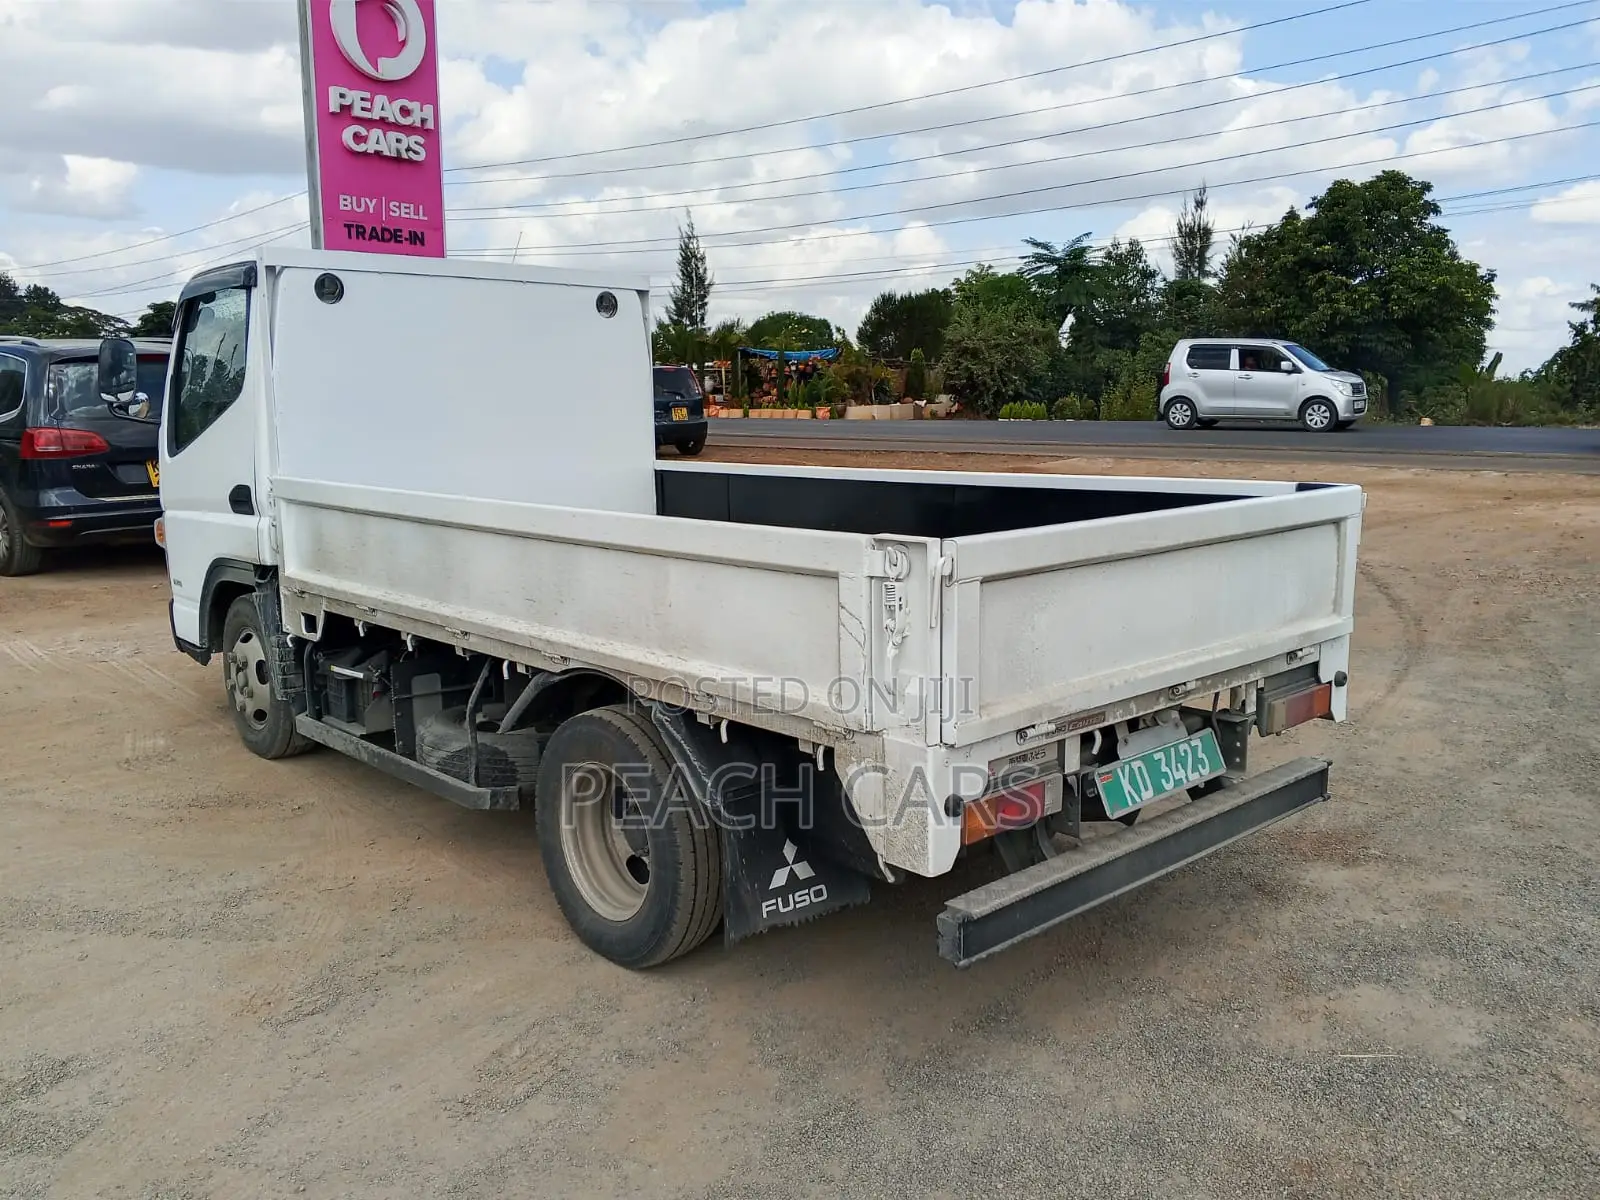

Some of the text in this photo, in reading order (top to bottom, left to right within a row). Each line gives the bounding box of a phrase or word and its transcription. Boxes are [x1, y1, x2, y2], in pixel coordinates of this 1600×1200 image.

[328, 85, 435, 130] PEACH
[341, 124, 427, 162] CARS
[339, 194, 428, 221] BUY SELL
[344, 223, 425, 247] TRADE-IN
[1117, 737, 1210, 807] KD 3423
[761, 884, 828, 919] FUSO
